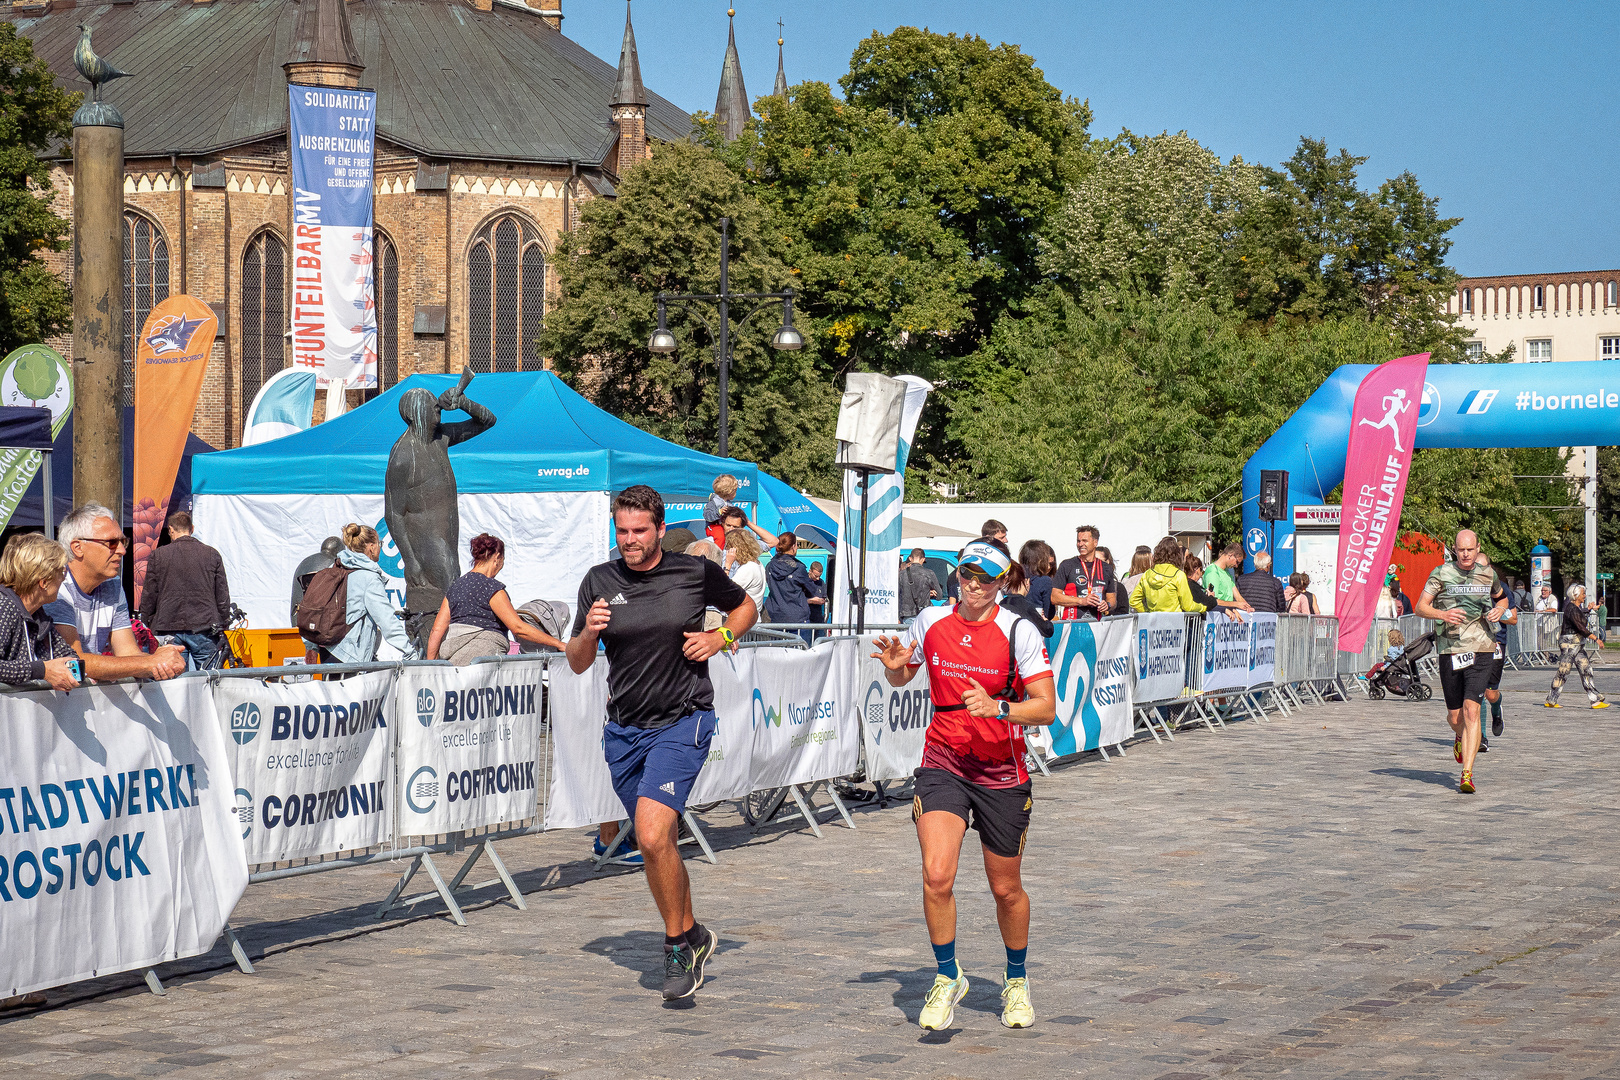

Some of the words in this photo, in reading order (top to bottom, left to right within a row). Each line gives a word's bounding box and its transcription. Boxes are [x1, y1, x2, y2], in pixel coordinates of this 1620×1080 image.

[304, 91, 371, 111] SOLIDARITÄT
[339, 115, 370, 132] STATT
[299, 134, 370, 153] AUSGRENZUNG
[324, 154, 336, 166] FÜR
[337, 156, 352, 167] EINE
[353, 158, 370, 167] FREIE
[327, 177, 370, 188] GESELLSCHAFT
[334, 167, 346, 177] UND
[347, 168, 370, 178] OFFENE
[3, 449, 42, 503] Rostoc
[537, 464, 590, 479] swrag.de
[1355, 454, 1403, 584] FRAUENLAUF
[1339, 484, 1377, 593] ROSTOCKER
[941, 660, 999, 675] OstseeSparkasse
[941, 669, 968, 679] Rostock
[443, 684, 537, 723] BIOTRONIK
[889, 688, 934, 733] CORT
[266, 749, 334, 770] excellence
[446, 761, 535, 803] CORTRONIK
[262, 780, 385, 830] CORTRONIK
